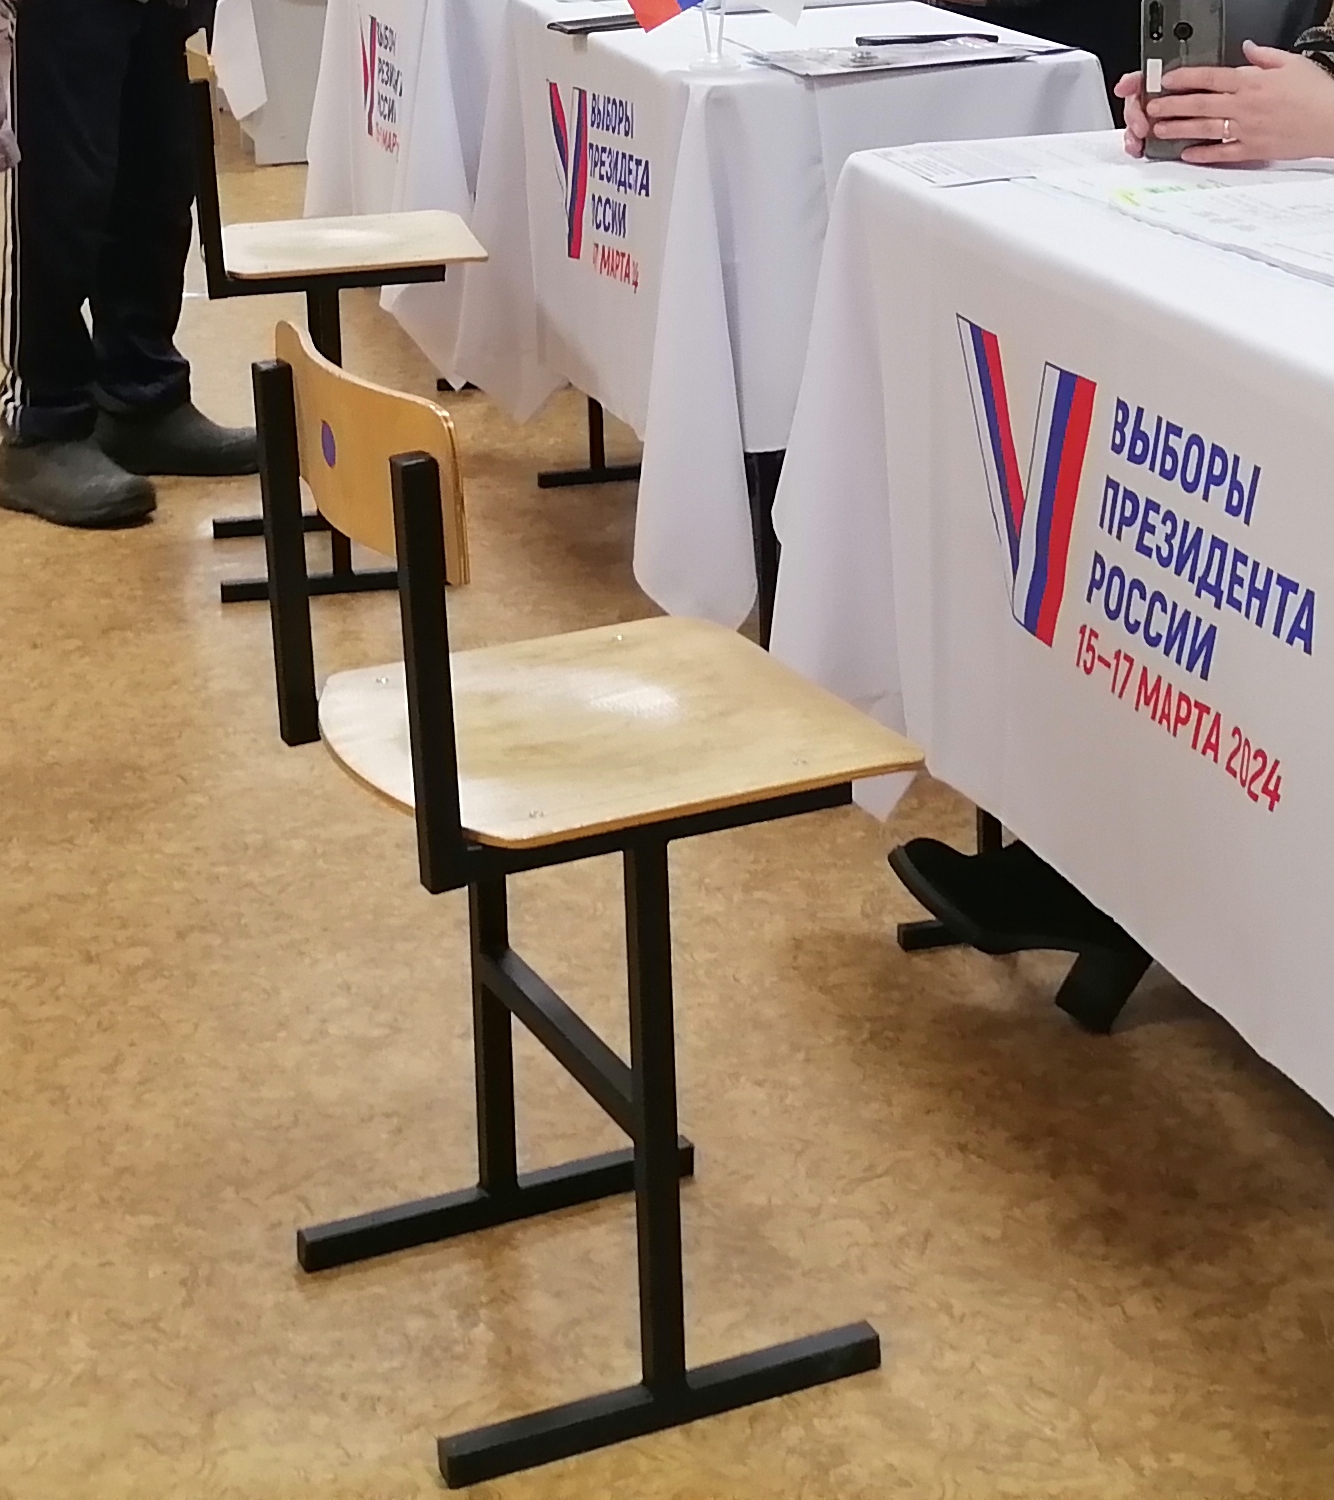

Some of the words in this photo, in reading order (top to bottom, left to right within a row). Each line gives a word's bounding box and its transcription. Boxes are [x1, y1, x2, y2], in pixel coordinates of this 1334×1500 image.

[590, 92, 634, 139] ВЫБОРЫ
[599, 244, 631, 286] МАРТА
[1110, 396, 1261, 526] ВЫБОРЫ
[1085, 550, 1218, 681] РОССИИ
[1098, 474, 1316, 656] ПРЕЗИДЕНТА
[1134, 665, 1221, 764] МАРТА
[1224, 725, 1282, 813] 2024
